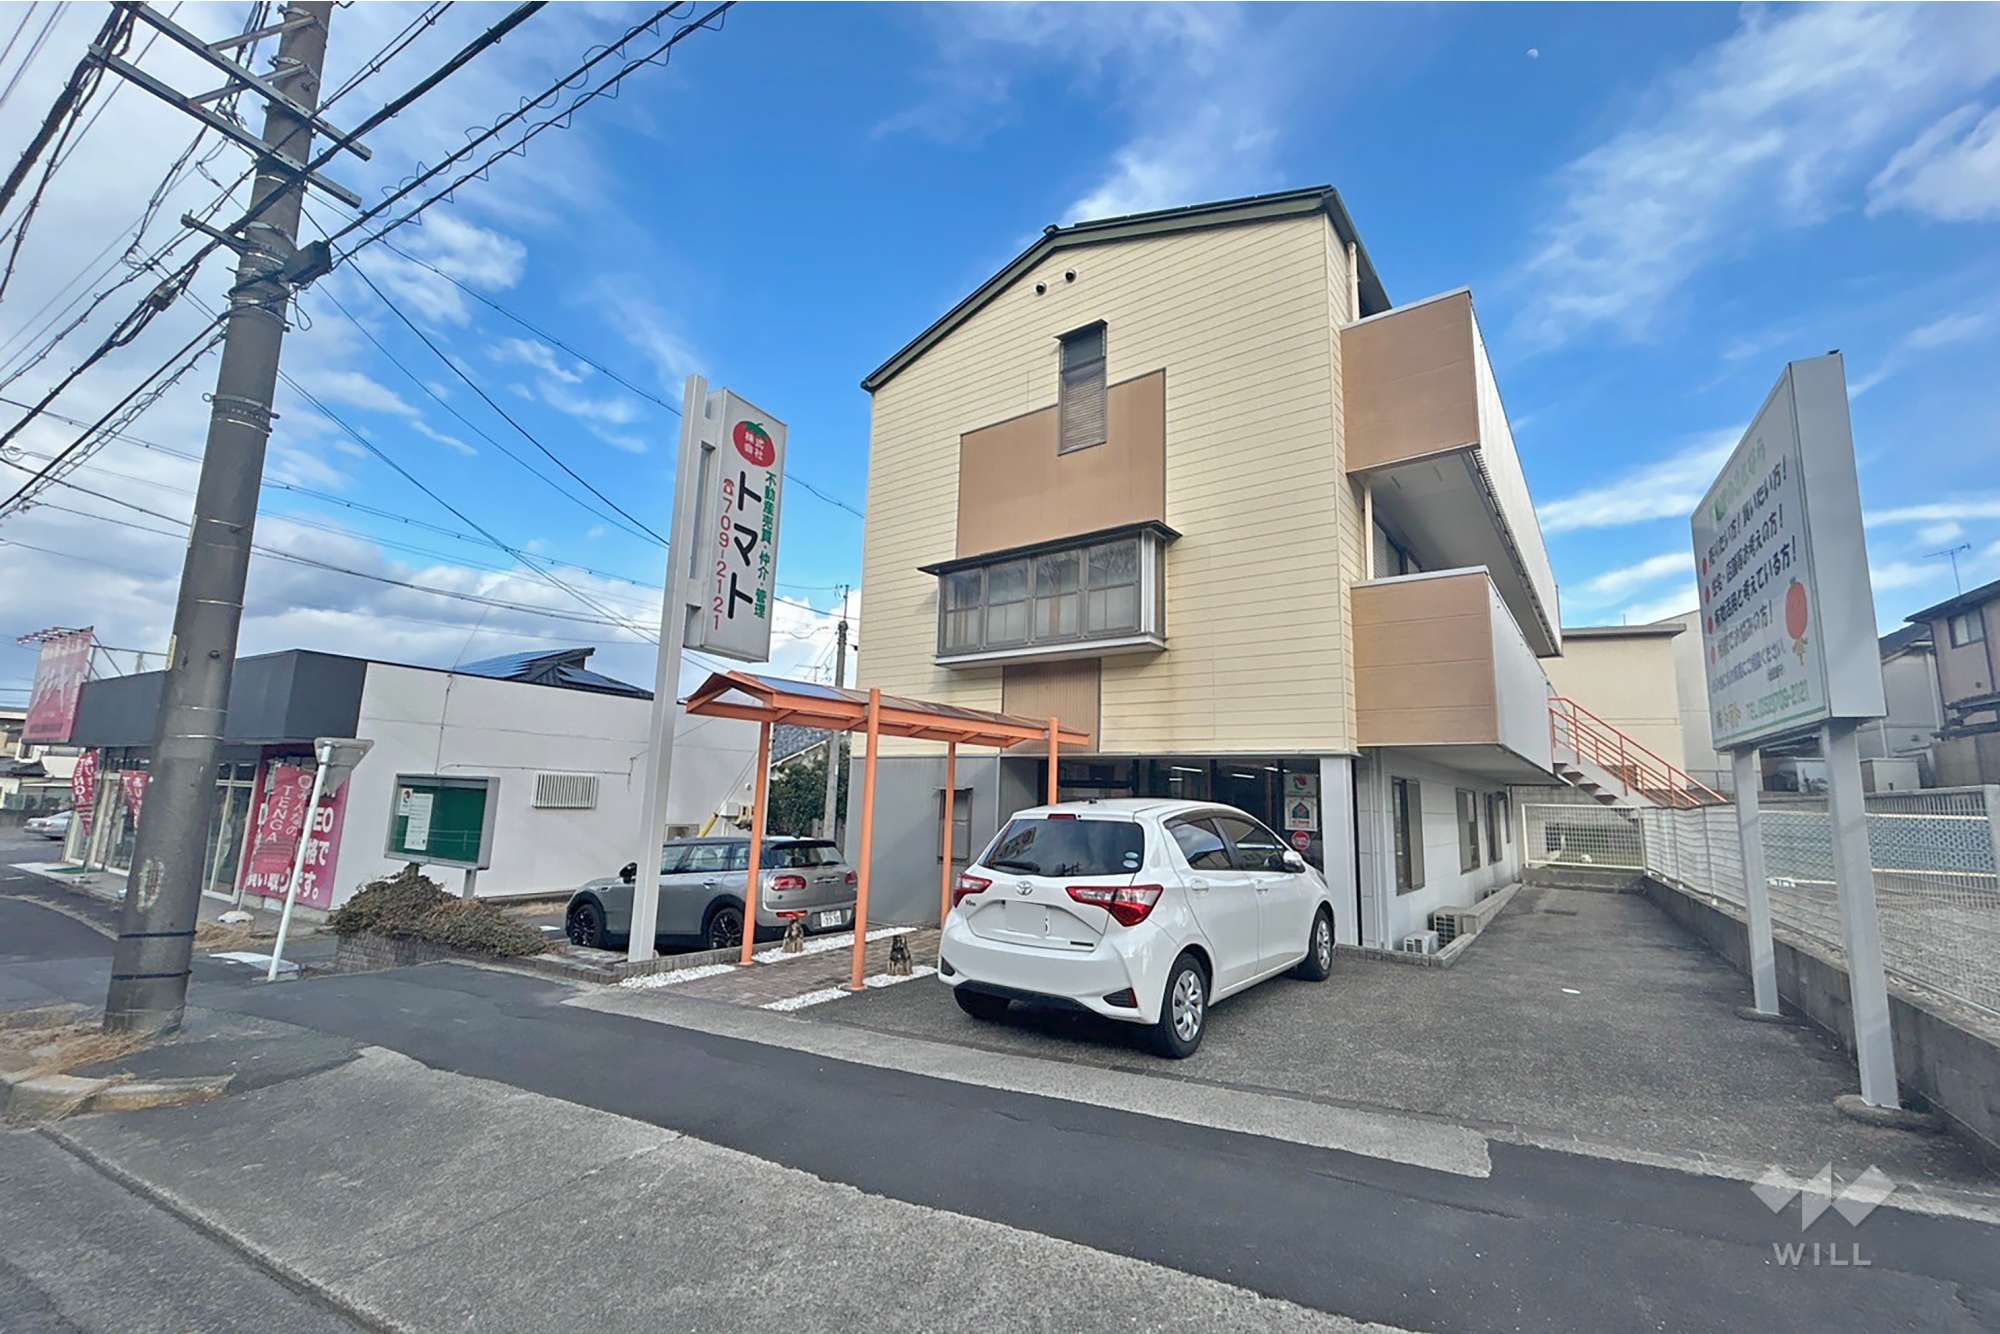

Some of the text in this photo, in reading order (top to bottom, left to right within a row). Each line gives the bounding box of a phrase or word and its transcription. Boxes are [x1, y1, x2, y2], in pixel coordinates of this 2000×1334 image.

[728, 470, 762, 619] トマト
[265, 785, 294, 842] TENGA
